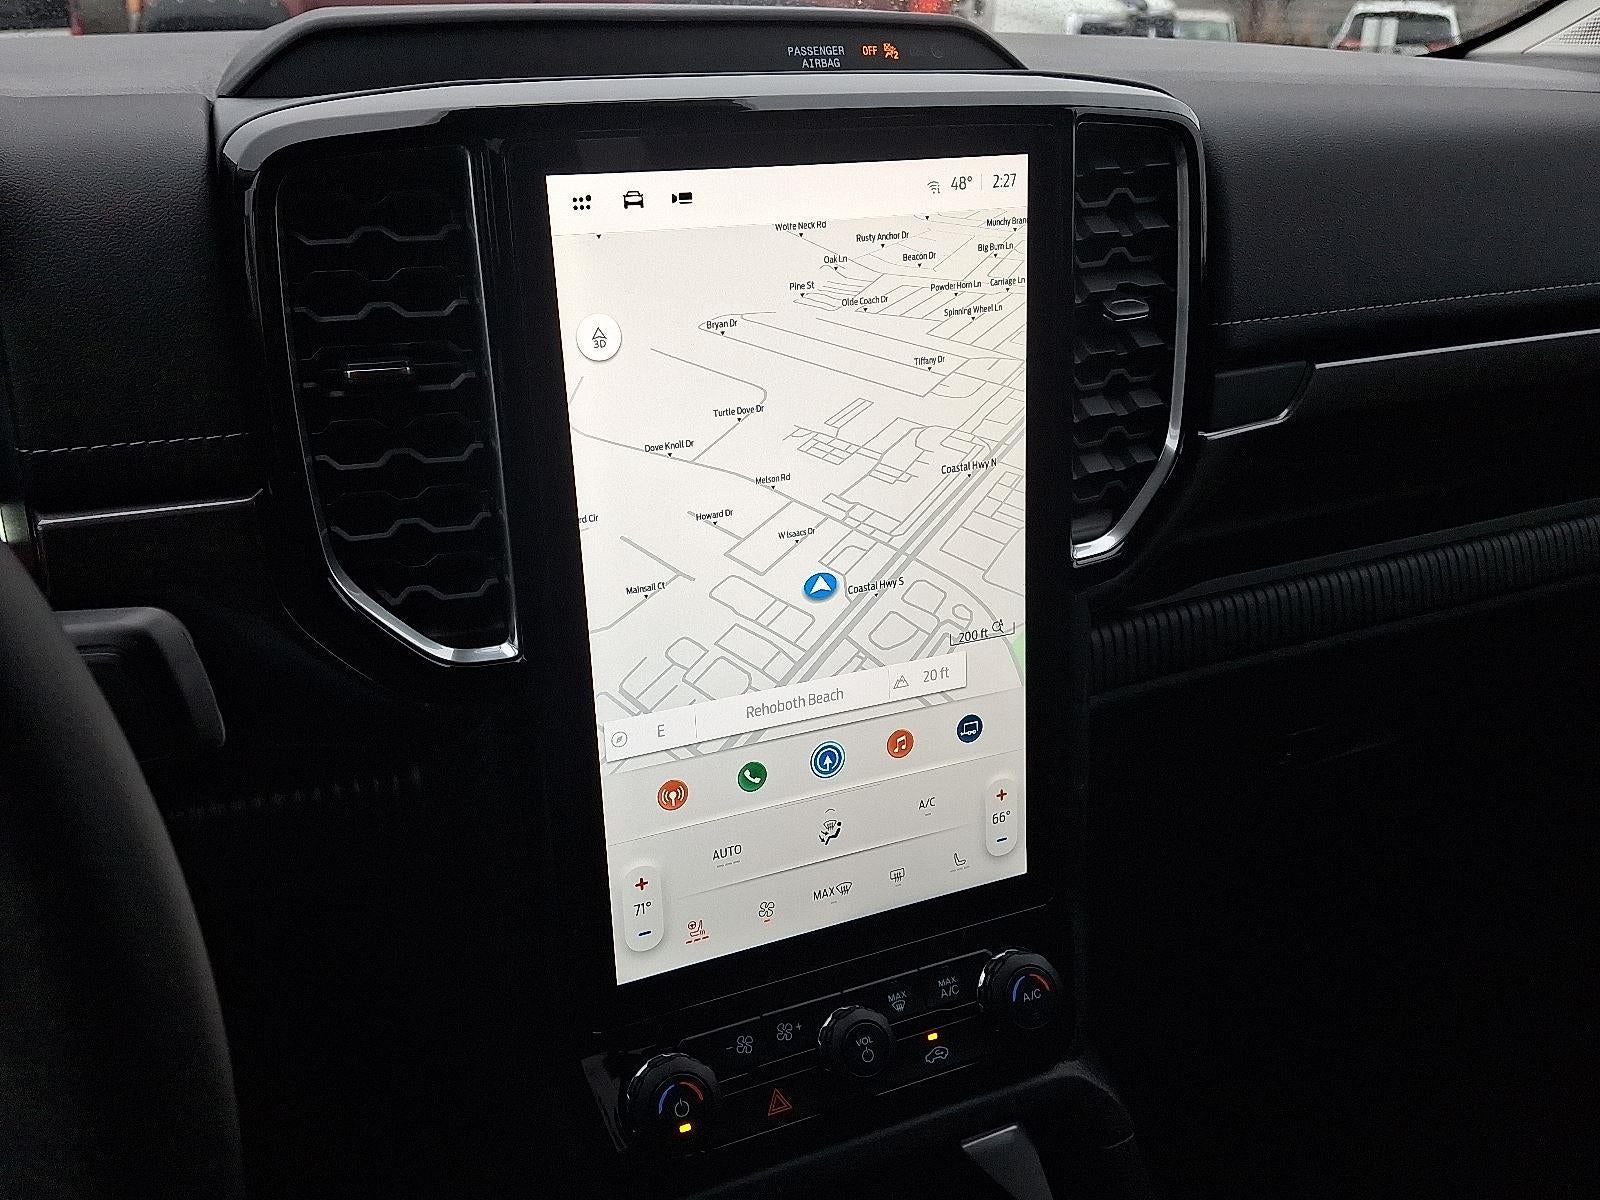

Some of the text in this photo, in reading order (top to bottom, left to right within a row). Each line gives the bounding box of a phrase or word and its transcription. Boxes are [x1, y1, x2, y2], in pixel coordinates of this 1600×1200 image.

[787, 46, 845, 56] PASSENGER
[862, 45, 878, 56] OFF
[802, 57, 841, 68] AIRBAG
[993, 173, 1017, 188] 2:27
[798, 221, 816, 230] Neck
[816, 220, 827, 229] Rd
[986, 217, 1011, 227] Munchy
[856, 231, 909, 244] Rusty Anchor Dr
[978, 243, 988, 253] Big
[1005, 242, 1014, 250] Ln
[824, 254, 848, 264] Oak Ln
[903, 251, 937, 262] Beacon Dr
[789, 280, 815, 291] Pine St
[930, 279, 982, 292] Powder Horn Ln
[1017, 276, 1026, 284] Ln
[841, 295, 889, 307] Olde Coach Dr
[943, 303, 1003, 316] Spinning Wheel Ln
[706, 318, 738, 330] Bryan Dr
[593, 340, 607, 349] 3D
[913, 354, 946, 366] Tiffany Dr
[713, 404, 765, 418] Turtle Dove Dr
[644, 439, 695, 452] Dove Knoll Dr
[941, 457, 998, 475] Coastal Hwy N
[755, 473, 791, 486] Melson Rd
[588, 513, 599, 523] Cir
[695, 508, 734, 521] Howard Dr
[778, 527, 816, 540] W Isaacs Dr
[625, 581, 665, 595] Mainsail Ct
[847, 576, 905, 595] Coastal Hwy S
[958, 627, 989, 643] 200 ft
[922, 667, 950, 683] 20 ft
[746, 687, 844, 719] Rehoboth Beach
[657, 724, 666, 738] E
[918, 796, 937, 811] A/C
[992, 810, 1011, 825] 66°
[712, 844, 742, 861] AUTO
[813, 885, 836, 901] MAX
[633, 901, 653, 917] 71°
[937, 976, 958, 987] MAX
[887, 990, 908, 1003] MAX
[941, 984, 960, 998] A/C
[1022, 988, 1042, 1003] A/C
[855, 1035, 874, 1047] VOL
